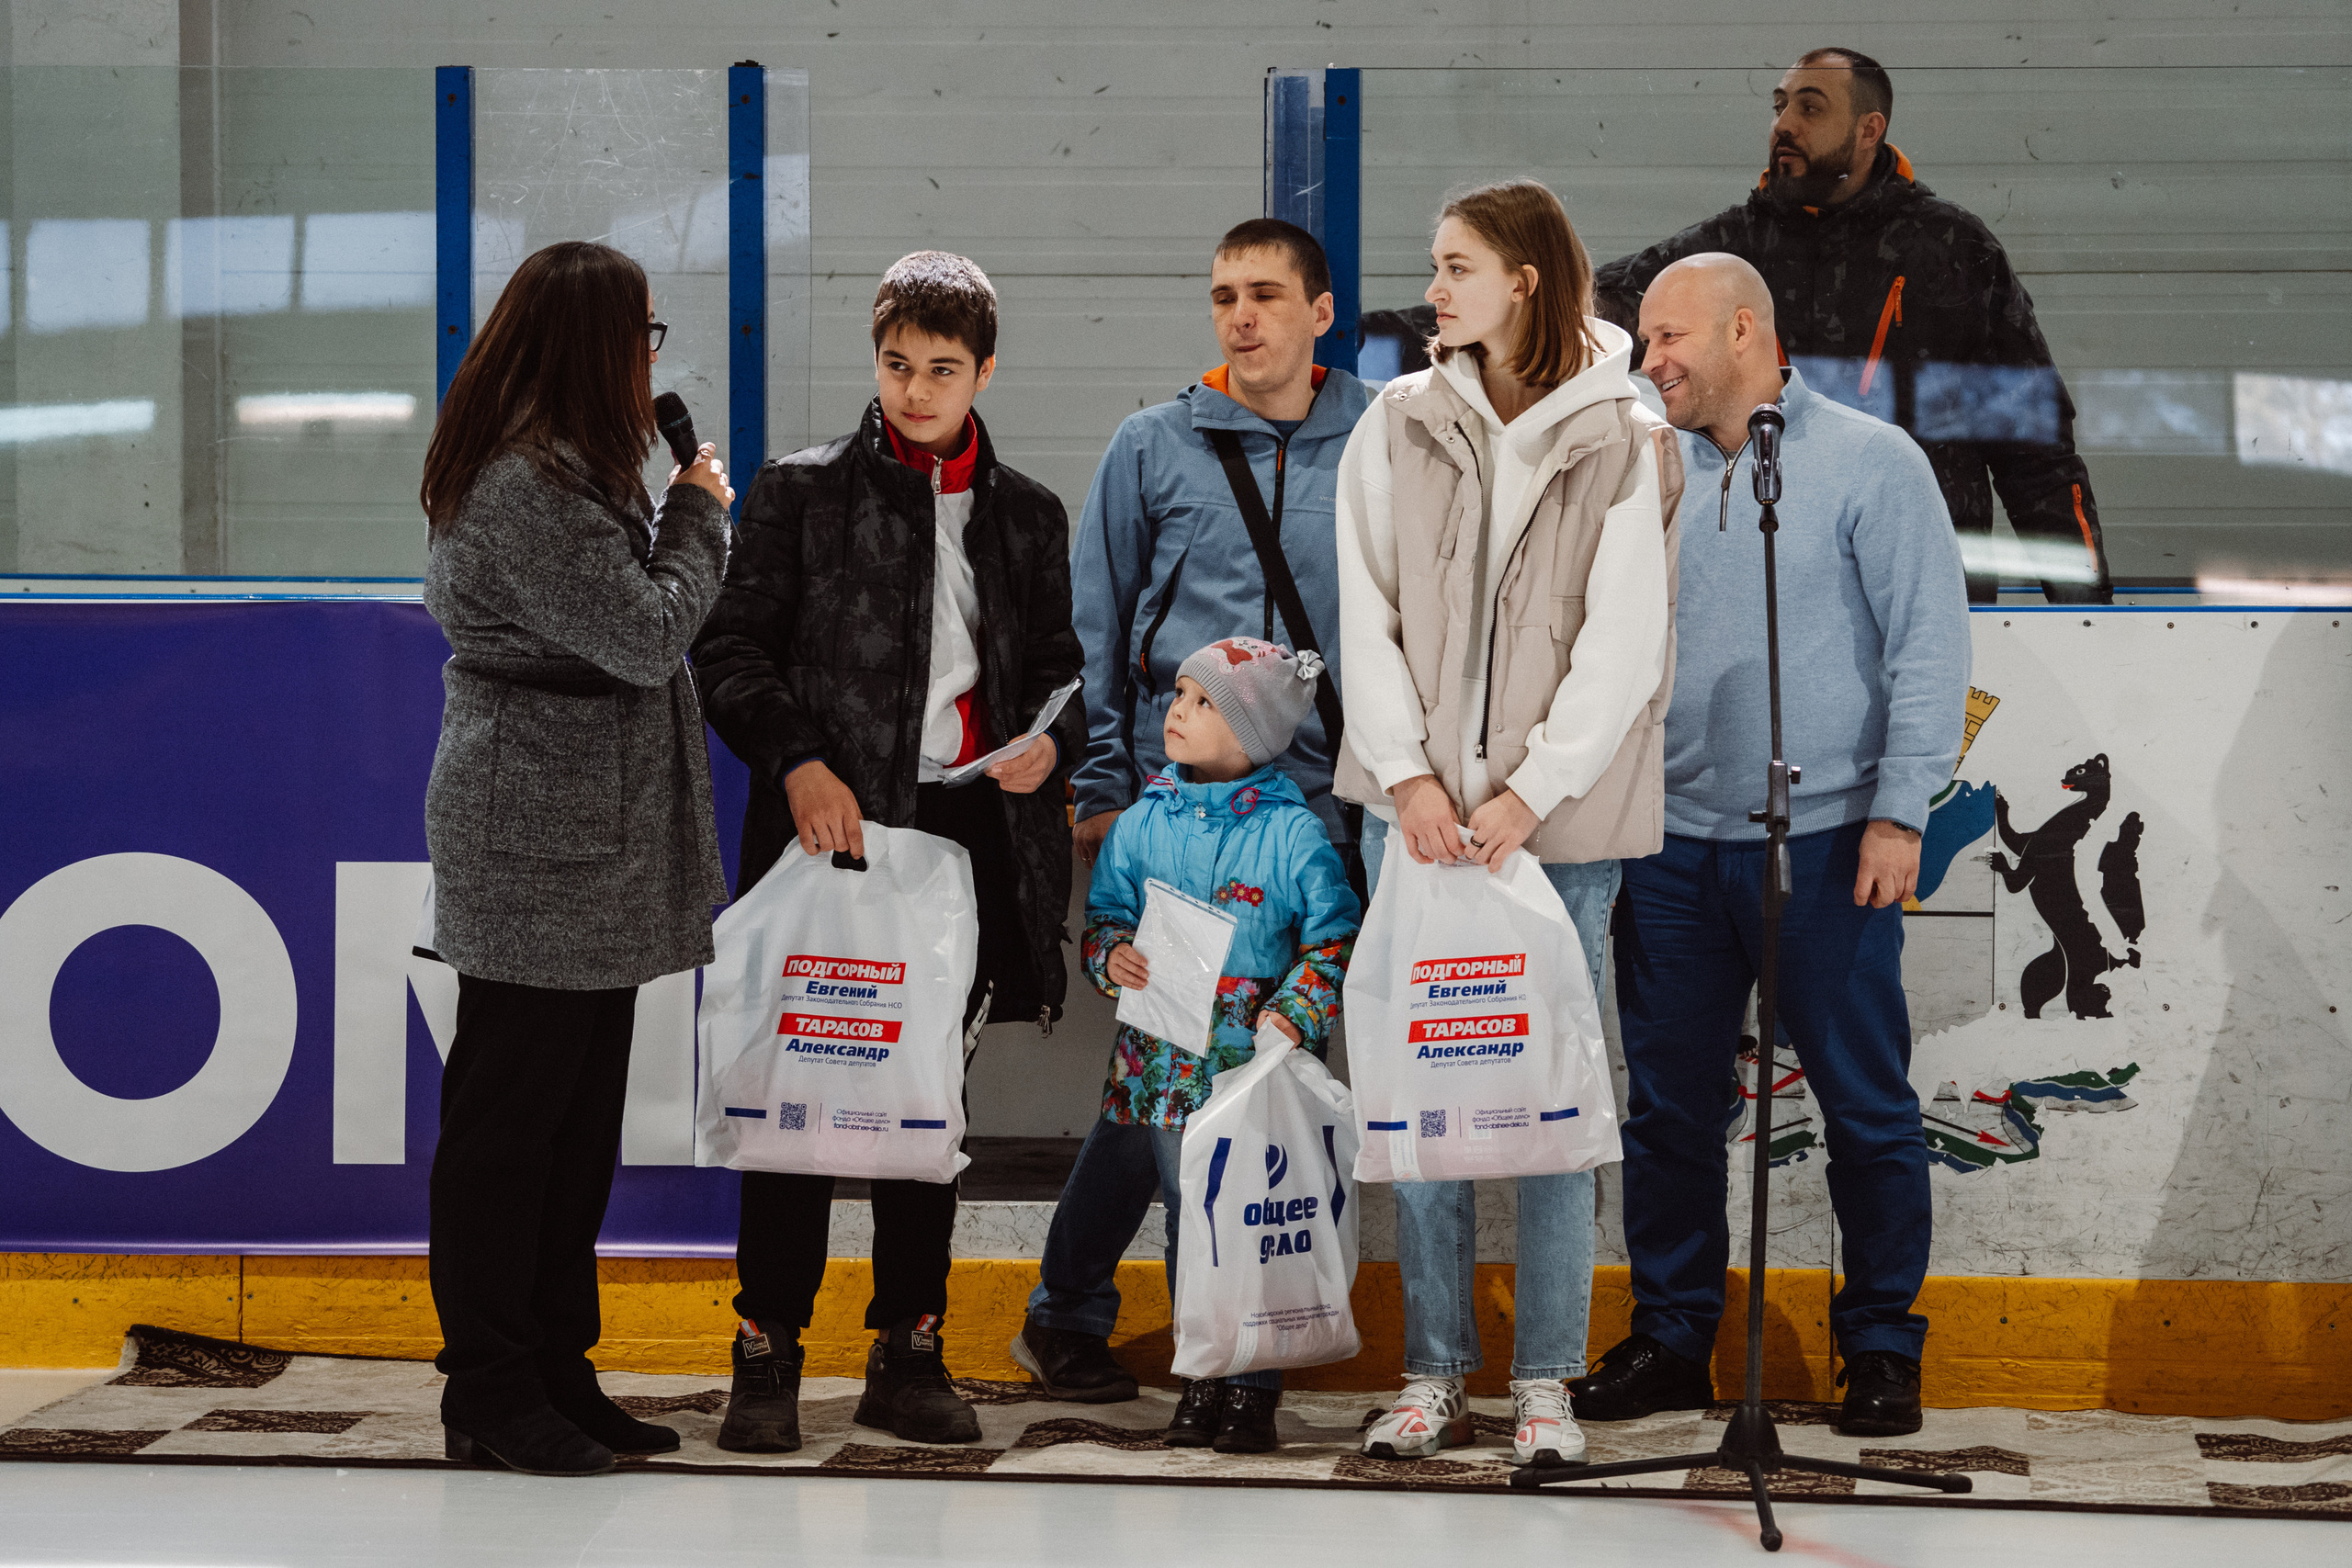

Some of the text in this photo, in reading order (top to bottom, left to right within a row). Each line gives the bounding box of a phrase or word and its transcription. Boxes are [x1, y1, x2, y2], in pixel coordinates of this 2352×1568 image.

[787, 960, 901, 981] ПОДГОРНЫЙ
[1412, 955, 1522, 981] ПОДГОРНЫЙ
[806, 980, 878, 998] Евгений
[1428, 979, 1507, 998] Евгений
[781, 994, 804, 1003] Депутат
[859, 999, 887, 1008] Собрания
[1430, 997, 1486, 1007] Законодательного
[1487, 993, 1518, 1003] Собрания
[796, 1017, 884, 1038] ТАРАСОВ
[1423, 1018, 1516, 1038] ТАРАСОВ
[786, 1038, 889, 1062] Александр
[1417, 1042, 1524, 1059] Александр
[798, 1055, 824, 1064] Депутат
[825, 1057, 847, 1066] Совета
[1430, 1061, 1456, 1069] Депутат
[1479, 1057, 1511, 1066] депутатов
